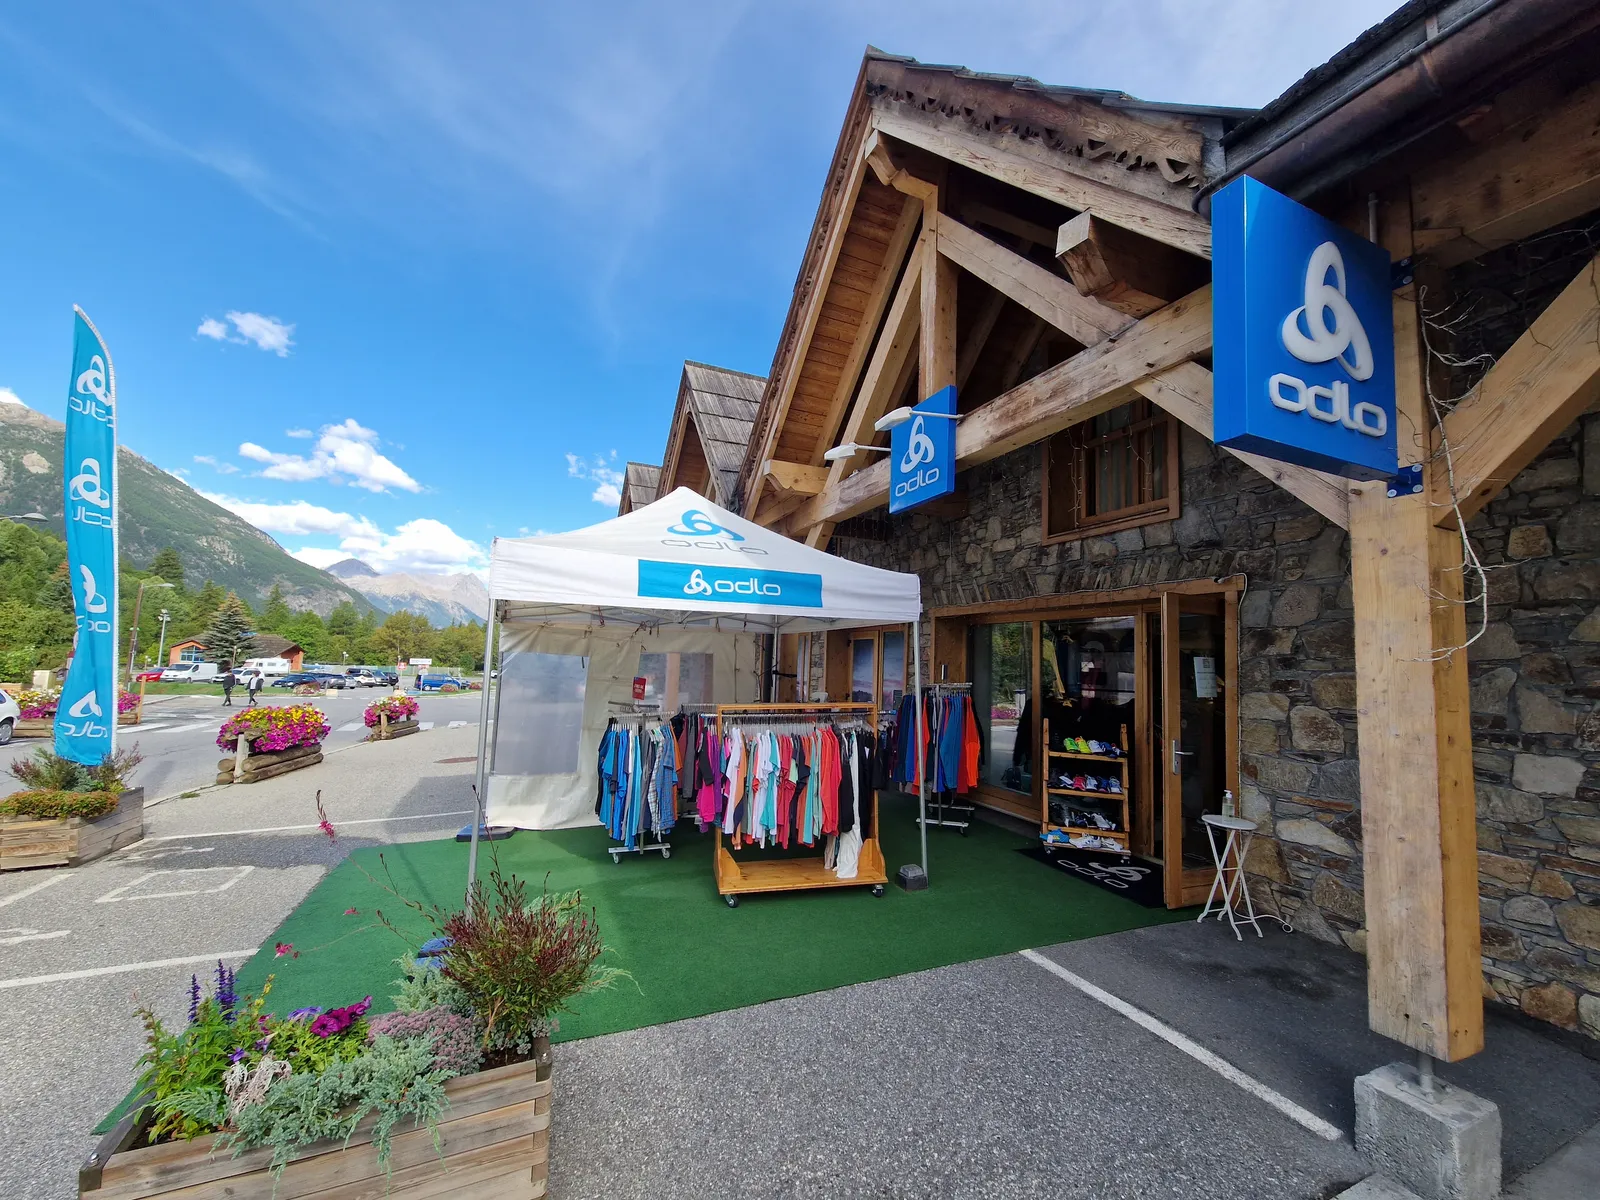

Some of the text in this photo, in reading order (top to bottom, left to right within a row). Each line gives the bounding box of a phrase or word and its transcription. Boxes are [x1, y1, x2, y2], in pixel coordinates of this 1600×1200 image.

[1268, 372, 1387, 438] odlo
[895, 467, 940, 497] odlo
[660, 539, 769, 555] odlo
[714, 577, 781, 596] odlo
[1057, 859, 1129, 889] odlo
